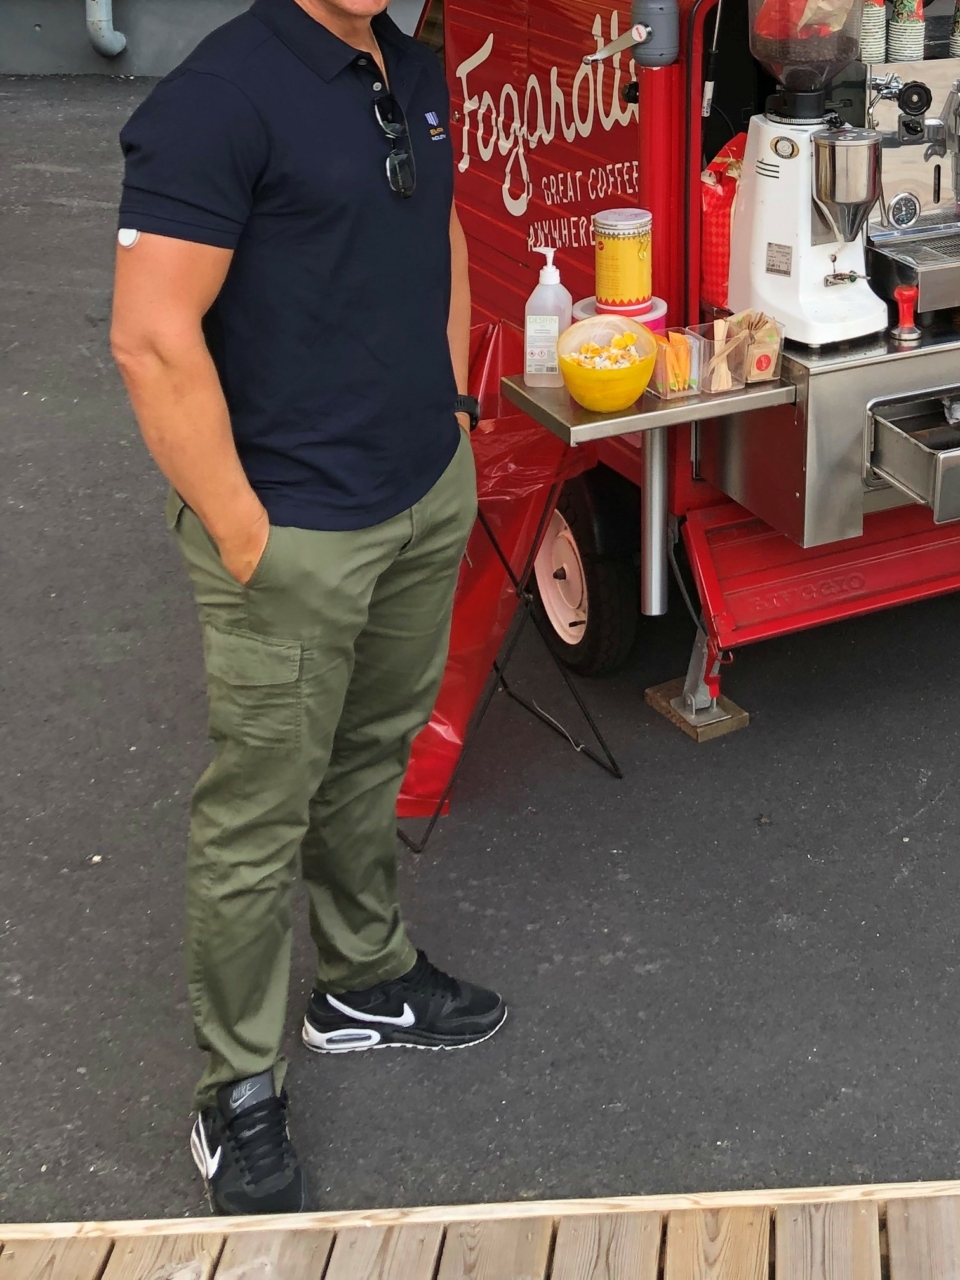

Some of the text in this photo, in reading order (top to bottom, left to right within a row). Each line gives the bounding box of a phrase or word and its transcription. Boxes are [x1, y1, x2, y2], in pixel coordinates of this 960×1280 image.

[541, 160, 639, 205] GREAT COFFEE
[528, 214, 596, 251] ANYWHERE
[528, 316, 557, 324] DESIFIN
[232, 1082, 252, 1101] NIKE
